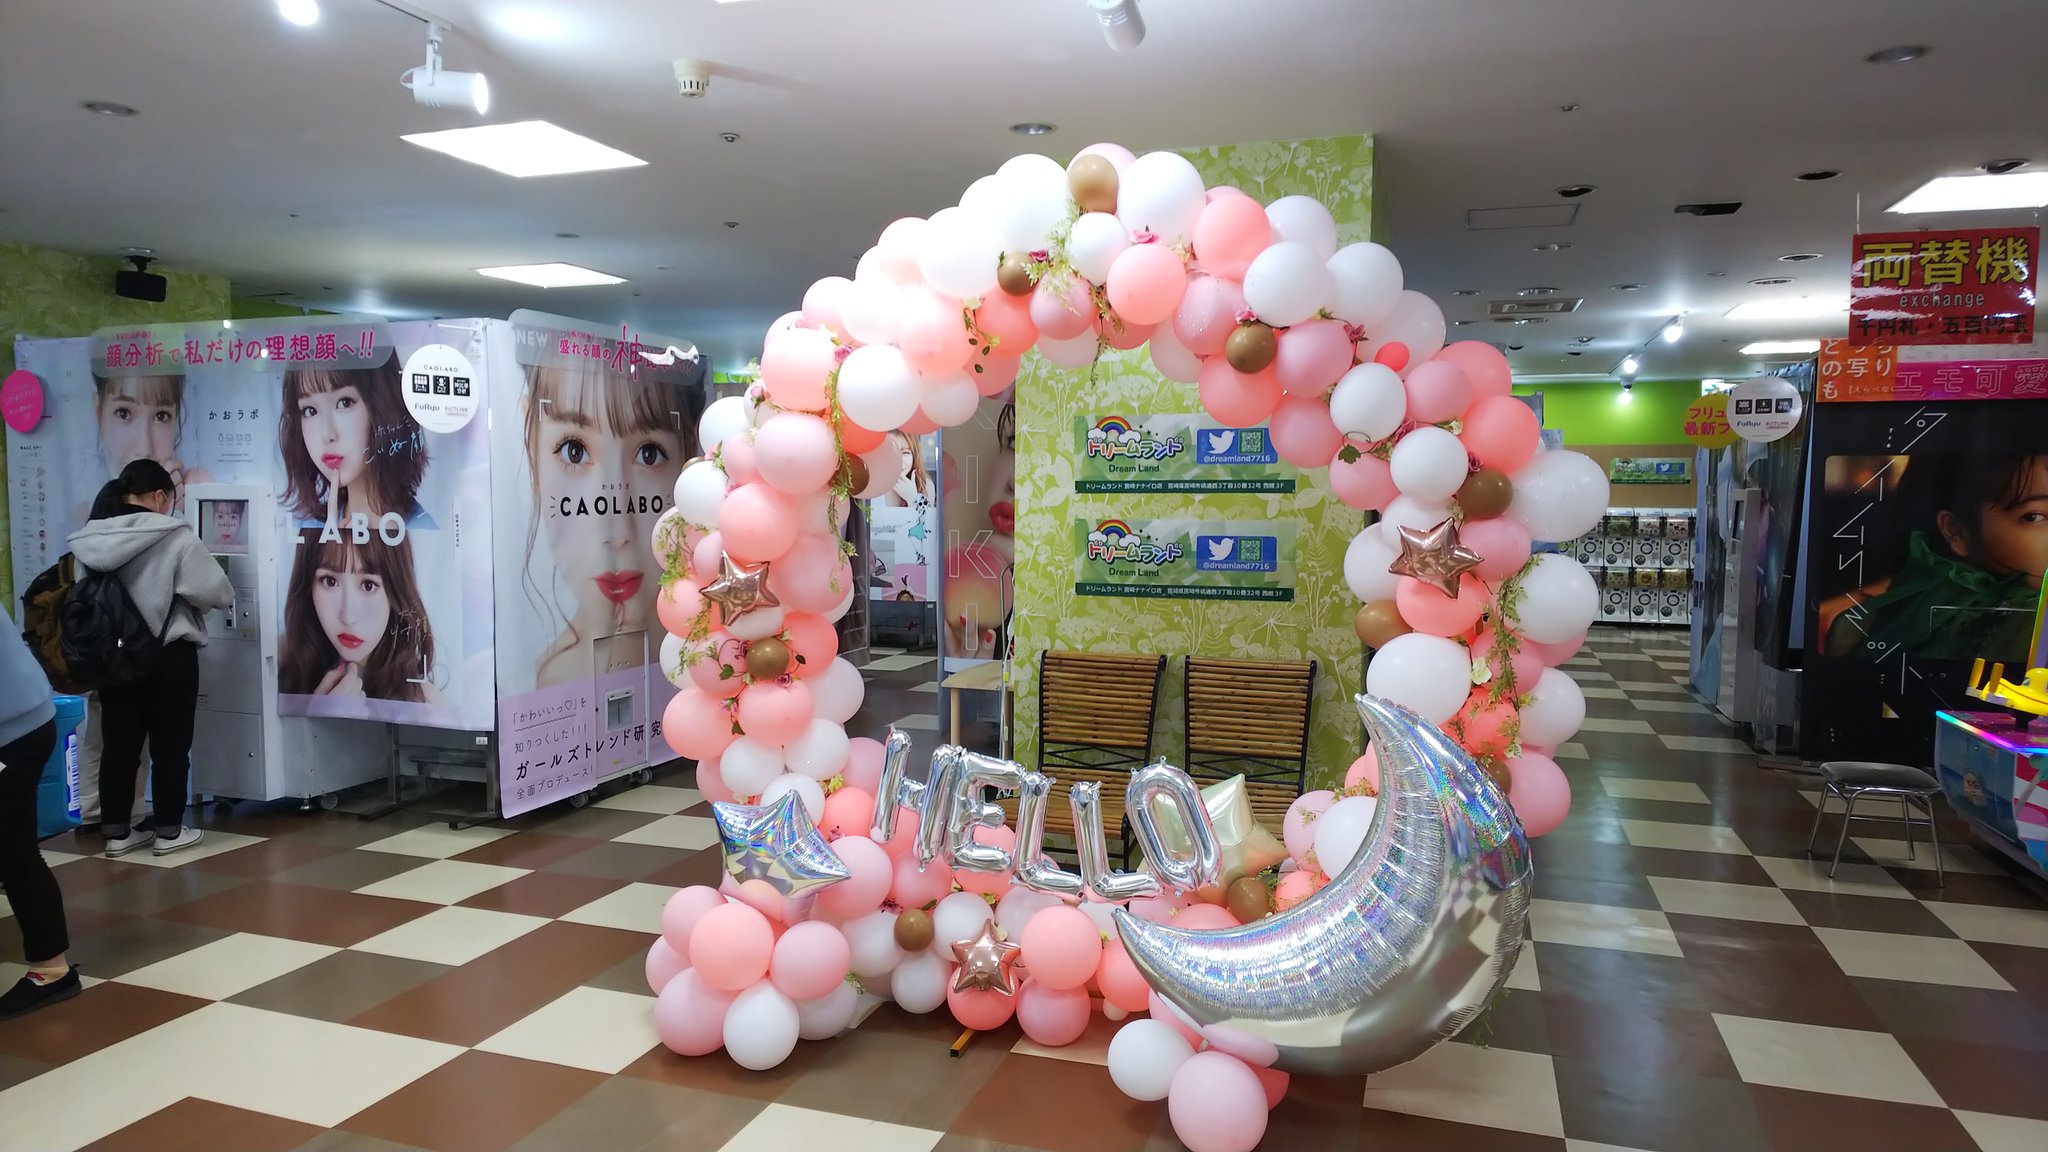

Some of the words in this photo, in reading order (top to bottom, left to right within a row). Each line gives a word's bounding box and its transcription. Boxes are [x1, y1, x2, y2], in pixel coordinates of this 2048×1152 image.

[1862, 236, 2029, 287] 両替機
[1899, 291, 1985, 308] exchange
[515, 327, 548, 347] NEW
[1087, 437, 1185, 460] ドリームランド
[1203, 455, 1271, 463] @dreamland7716
[1108, 464, 1137, 473] Dream
[1138, 464, 1160, 473] Land
[560, 494, 664, 517] CAOLABO
[286, 511, 406, 547] LABO
[1087, 540, 1185, 563] ドリームランド
[1108, 568, 1137, 577] Dream
[1138, 568, 1160, 577] Land
[1203, 562, 1271, 570] @dreamland7716
[516, 764, 593, 800] 全面プロデュース!
[869, 725, 1223, 900] HELLO
